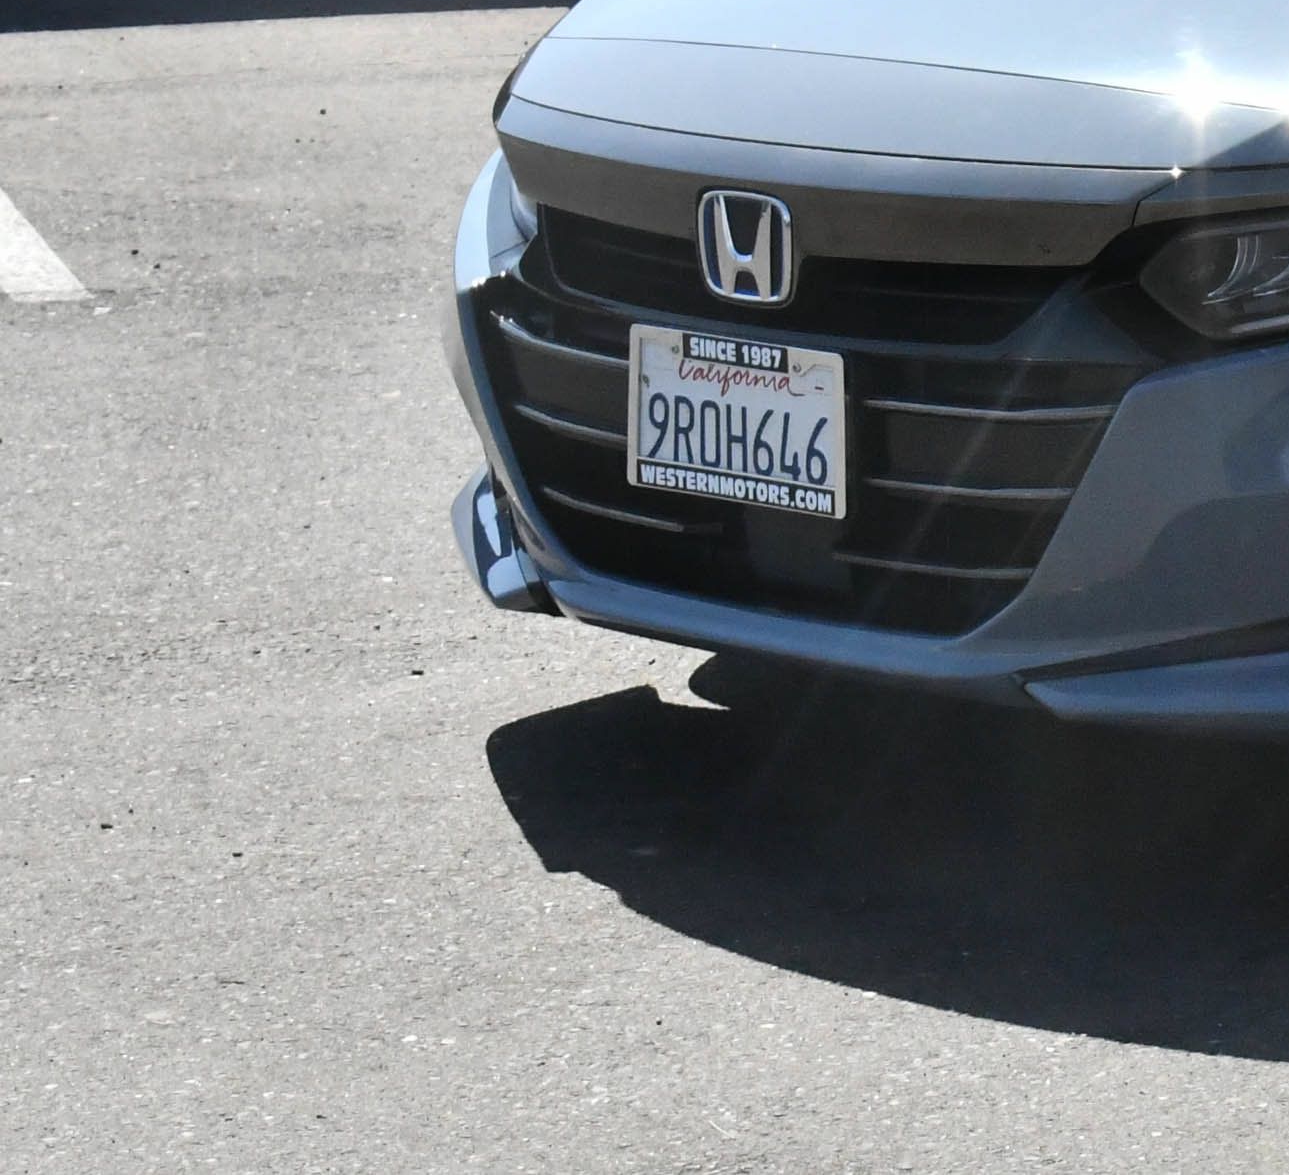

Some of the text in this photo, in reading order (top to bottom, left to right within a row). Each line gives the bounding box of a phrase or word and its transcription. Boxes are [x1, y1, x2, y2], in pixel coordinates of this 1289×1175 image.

[689, 336, 781, 368] SINCE 1987
[678, 359, 806, 397] California
[640, 463, 833, 514] WESTERNMOTORS.COM
